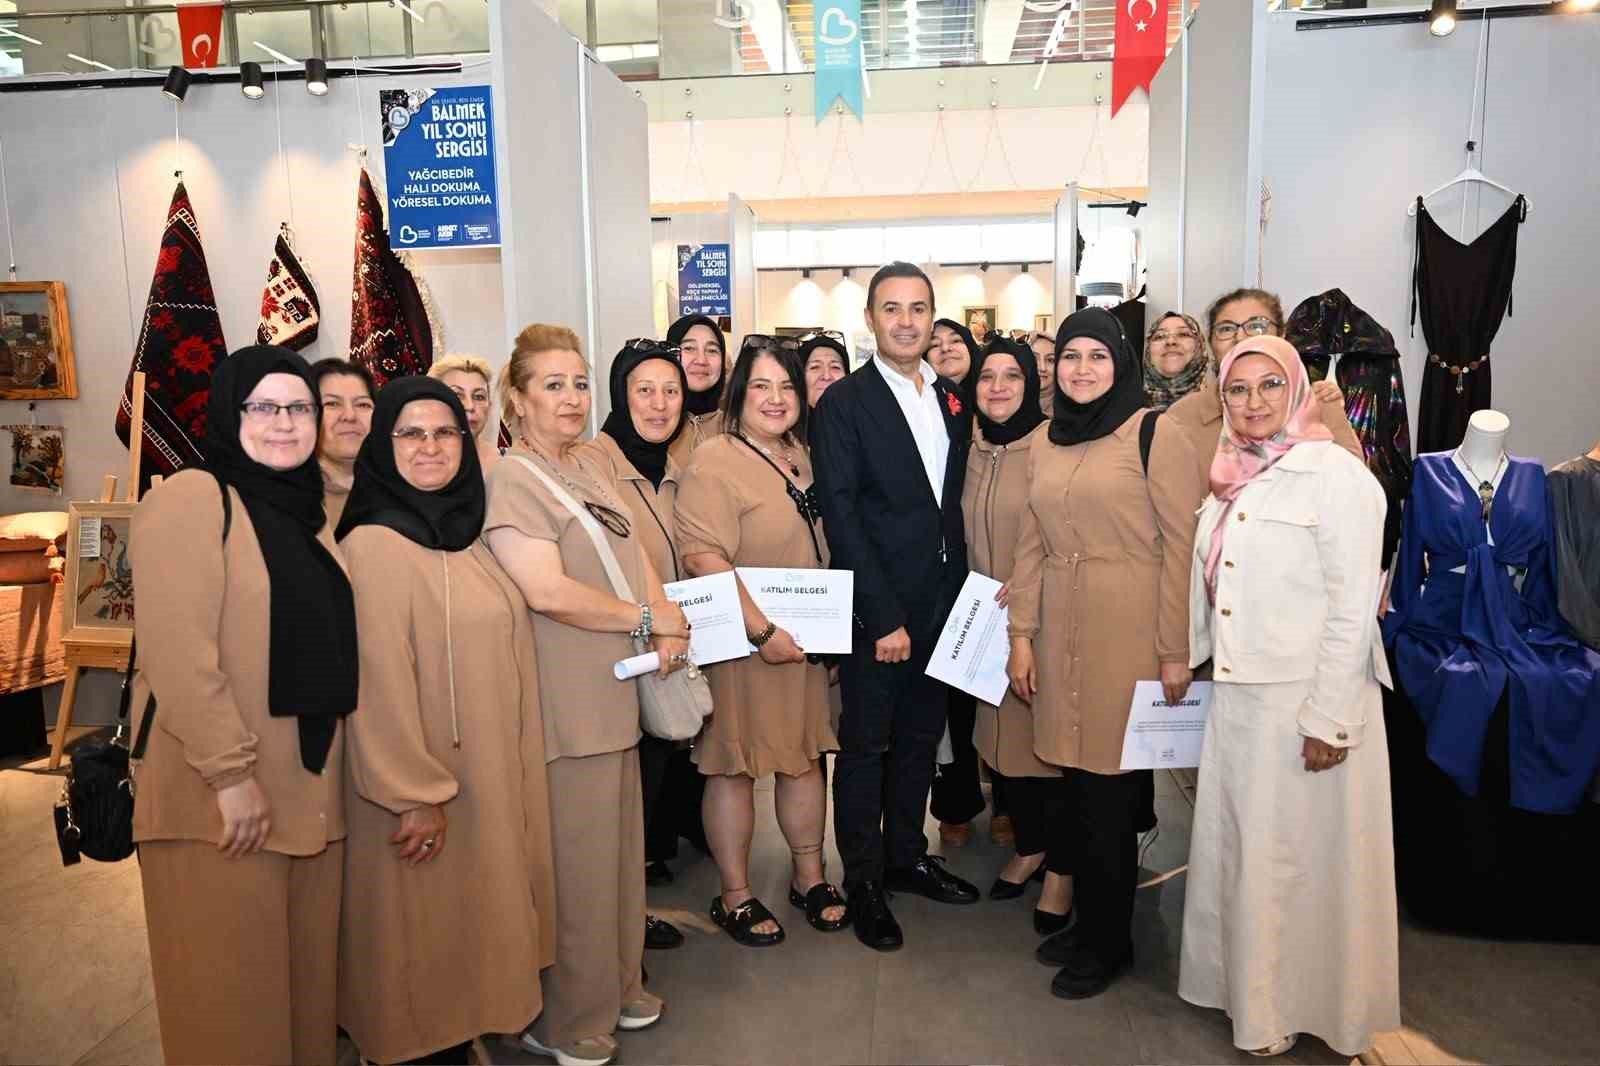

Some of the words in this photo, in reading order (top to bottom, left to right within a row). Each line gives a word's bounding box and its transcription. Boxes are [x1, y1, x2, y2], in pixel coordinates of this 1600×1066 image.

[431, 103, 486, 121] BALMEK
[421, 123, 443, 139] YIL
[445, 121, 487, 138] SONU
[435, 138, 488, 158] SERGİSİ
[408, 166, 474, 181] YAĞCIBEDİR
[404, 184, 429, 194] HALI
[431, 182, 481, 193] DOKUMA
[392, 196, 441, 208] YÖRESEL
[442, 194, 492, 206] DOKUMA
[760, 586, 793, 594] KATILIM
[794, 584, 828, 595] BELGESİ
[951, 629, 968, 660] KATILIM
